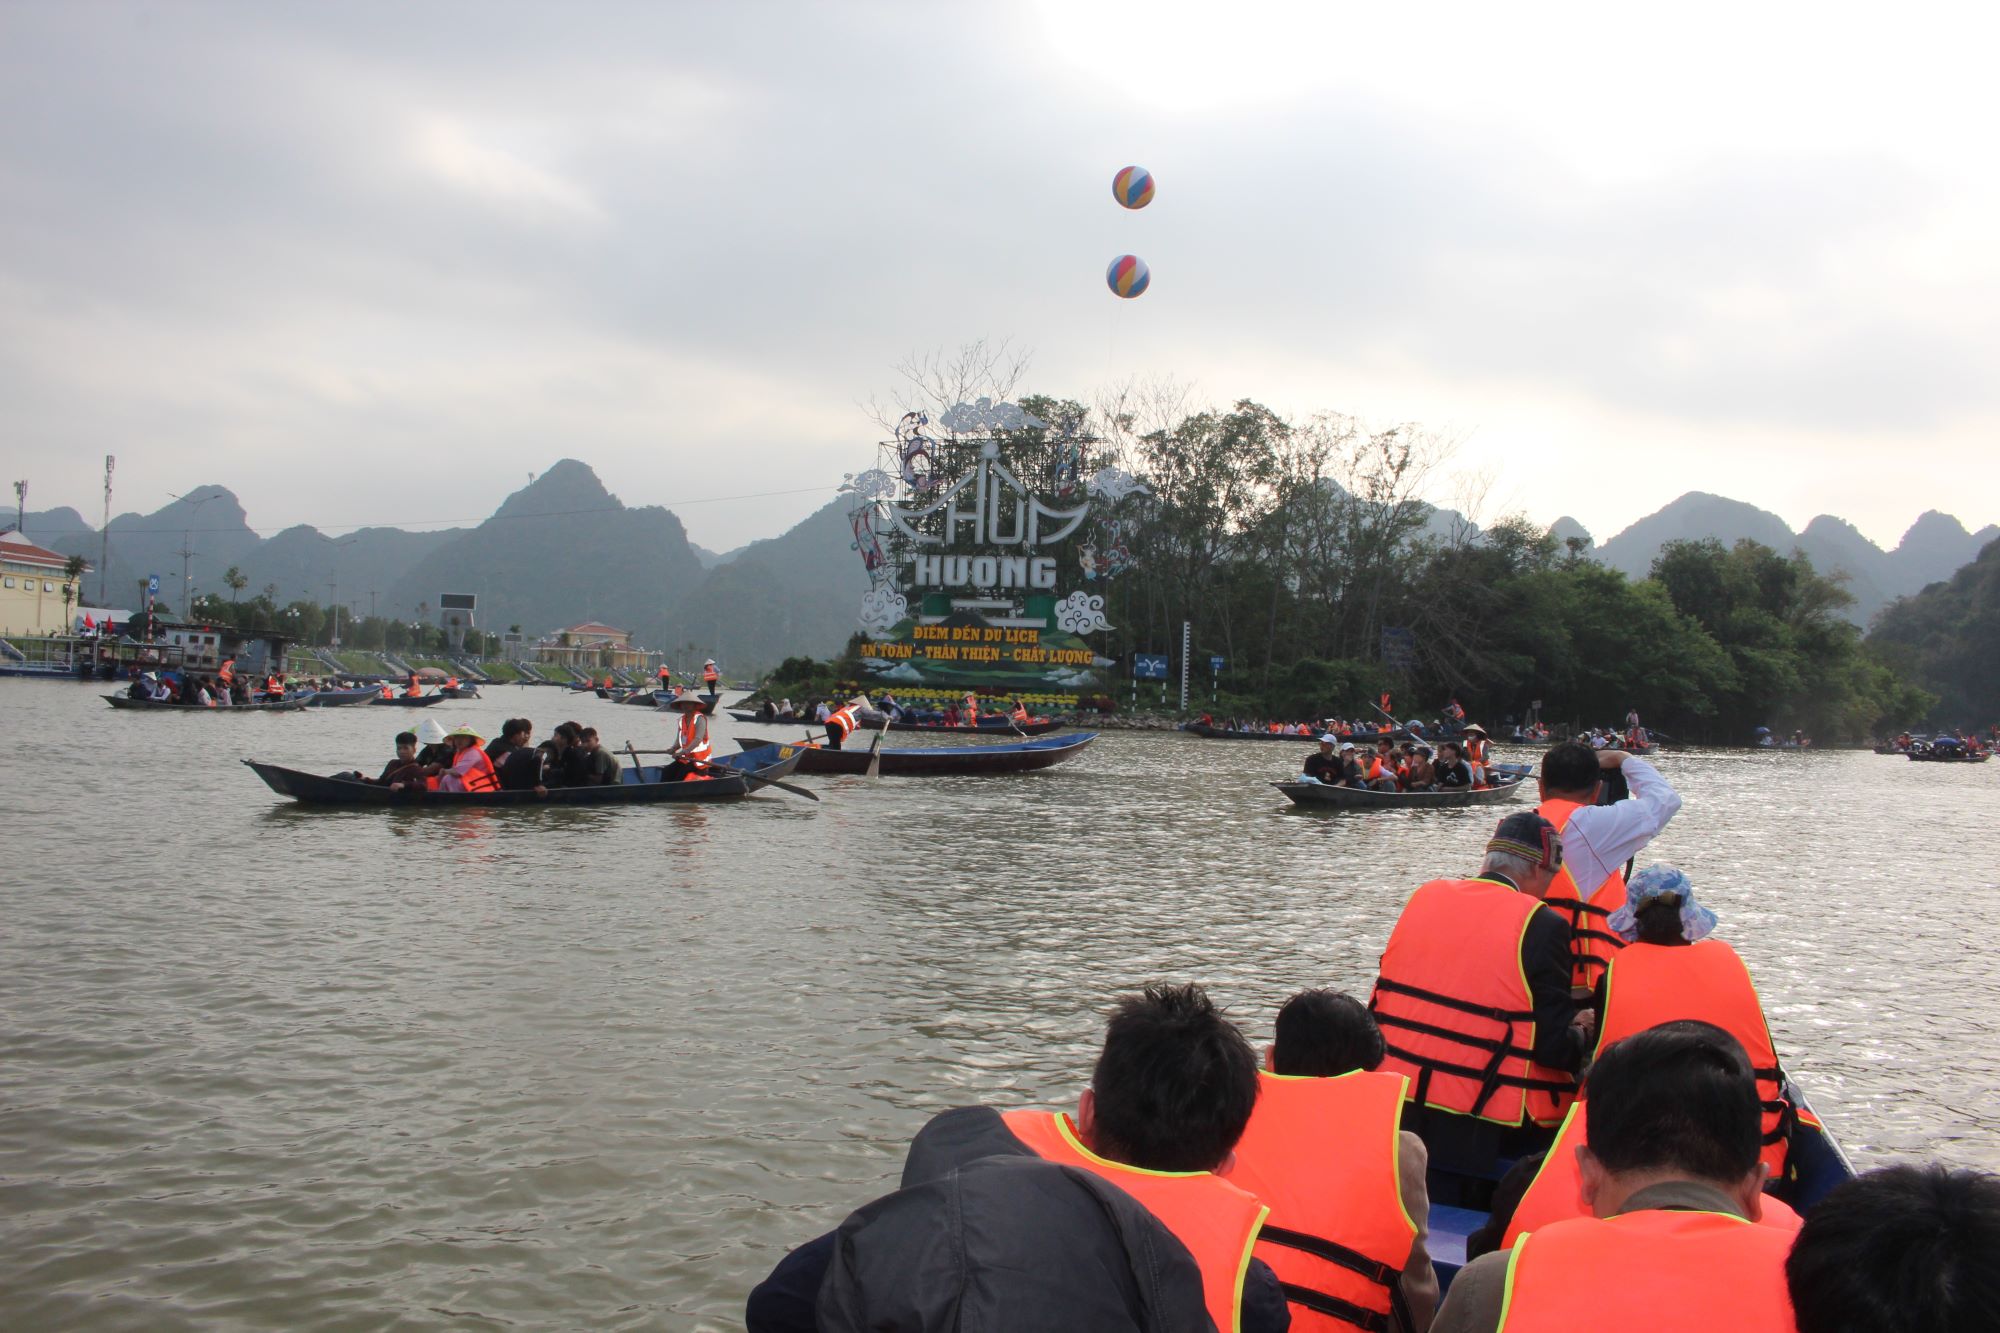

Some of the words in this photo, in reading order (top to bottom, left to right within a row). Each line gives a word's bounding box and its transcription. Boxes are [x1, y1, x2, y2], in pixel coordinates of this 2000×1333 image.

[984, 628, 1003, 642] DU
[1005, 629, 1039, 645] LỊCH
[860, 643, 878, 657] AN
